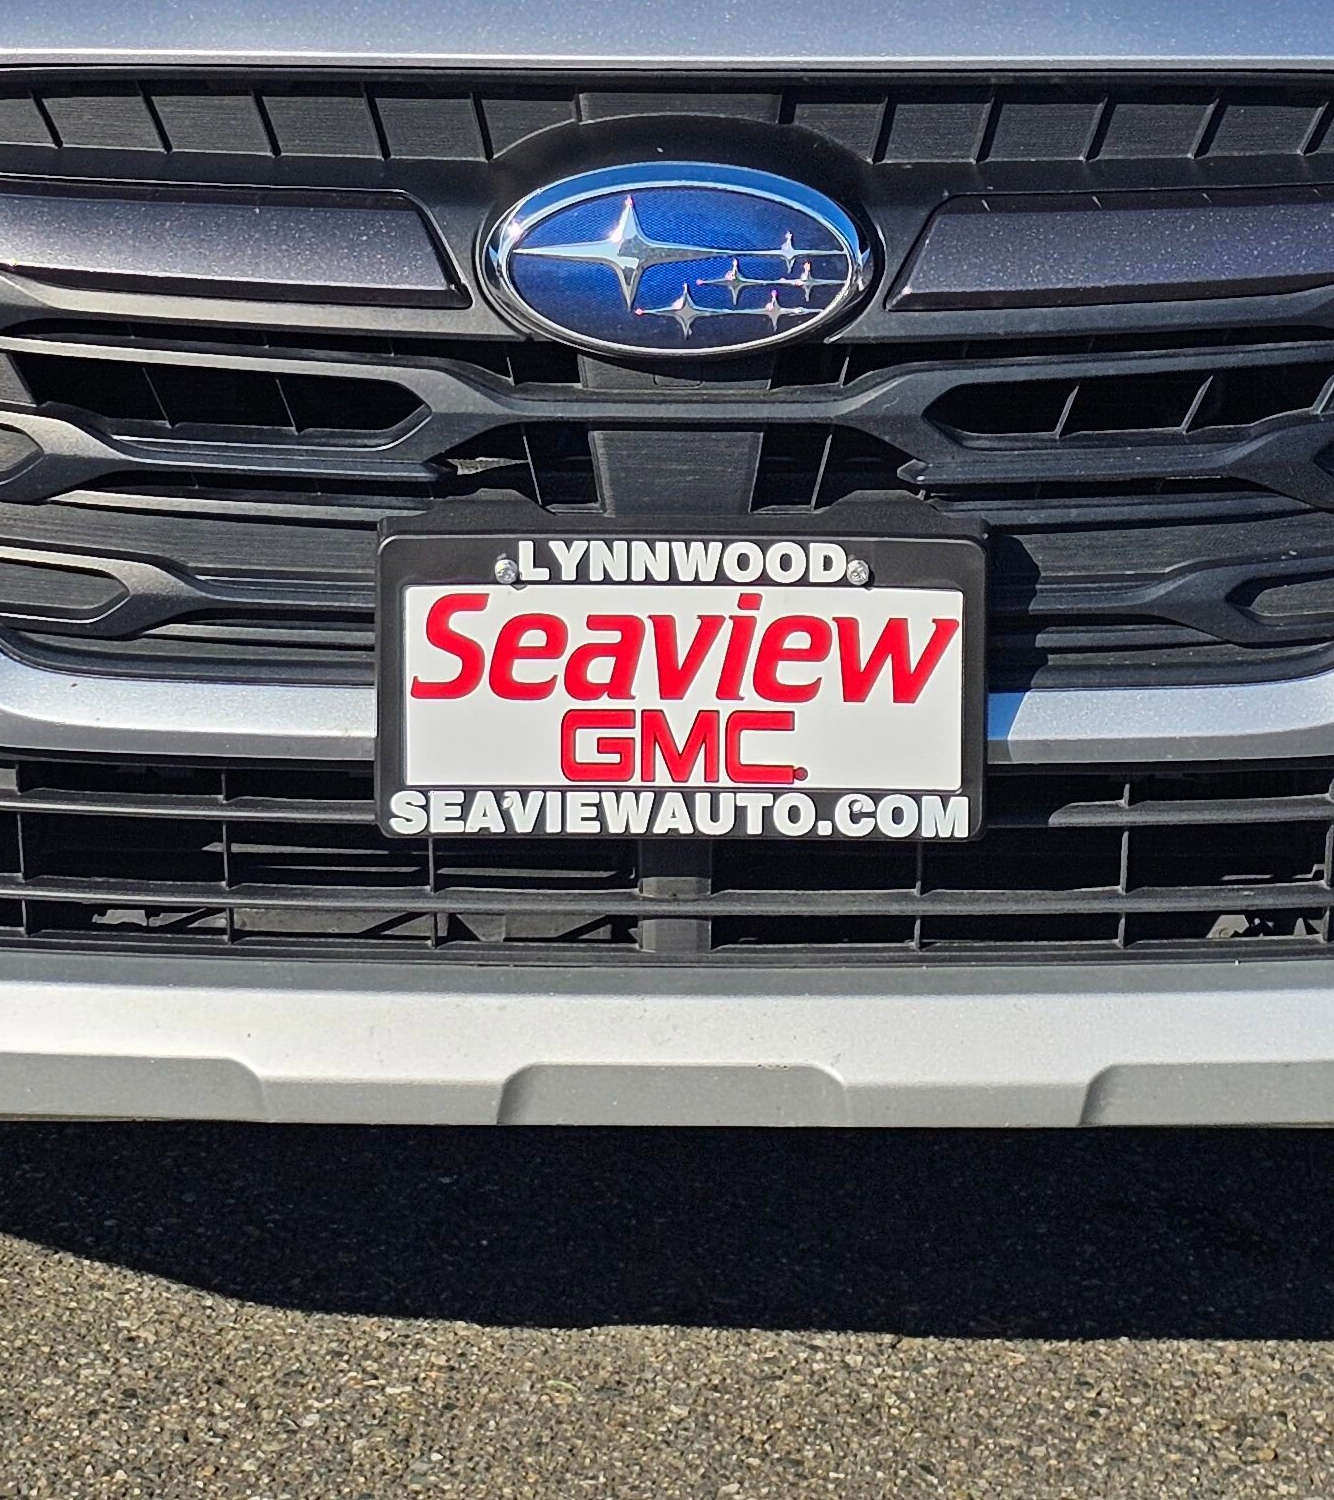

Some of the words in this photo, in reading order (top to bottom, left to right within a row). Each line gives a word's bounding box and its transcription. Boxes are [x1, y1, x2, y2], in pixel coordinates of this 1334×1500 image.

[518, 540, 849, 583] LYNNWOOD
[410, 592, 961, 704] Seaview
[560, 708, 808, 784] GMC
[389, 790, 970, 839] SEAVIEWAUTO.COM
